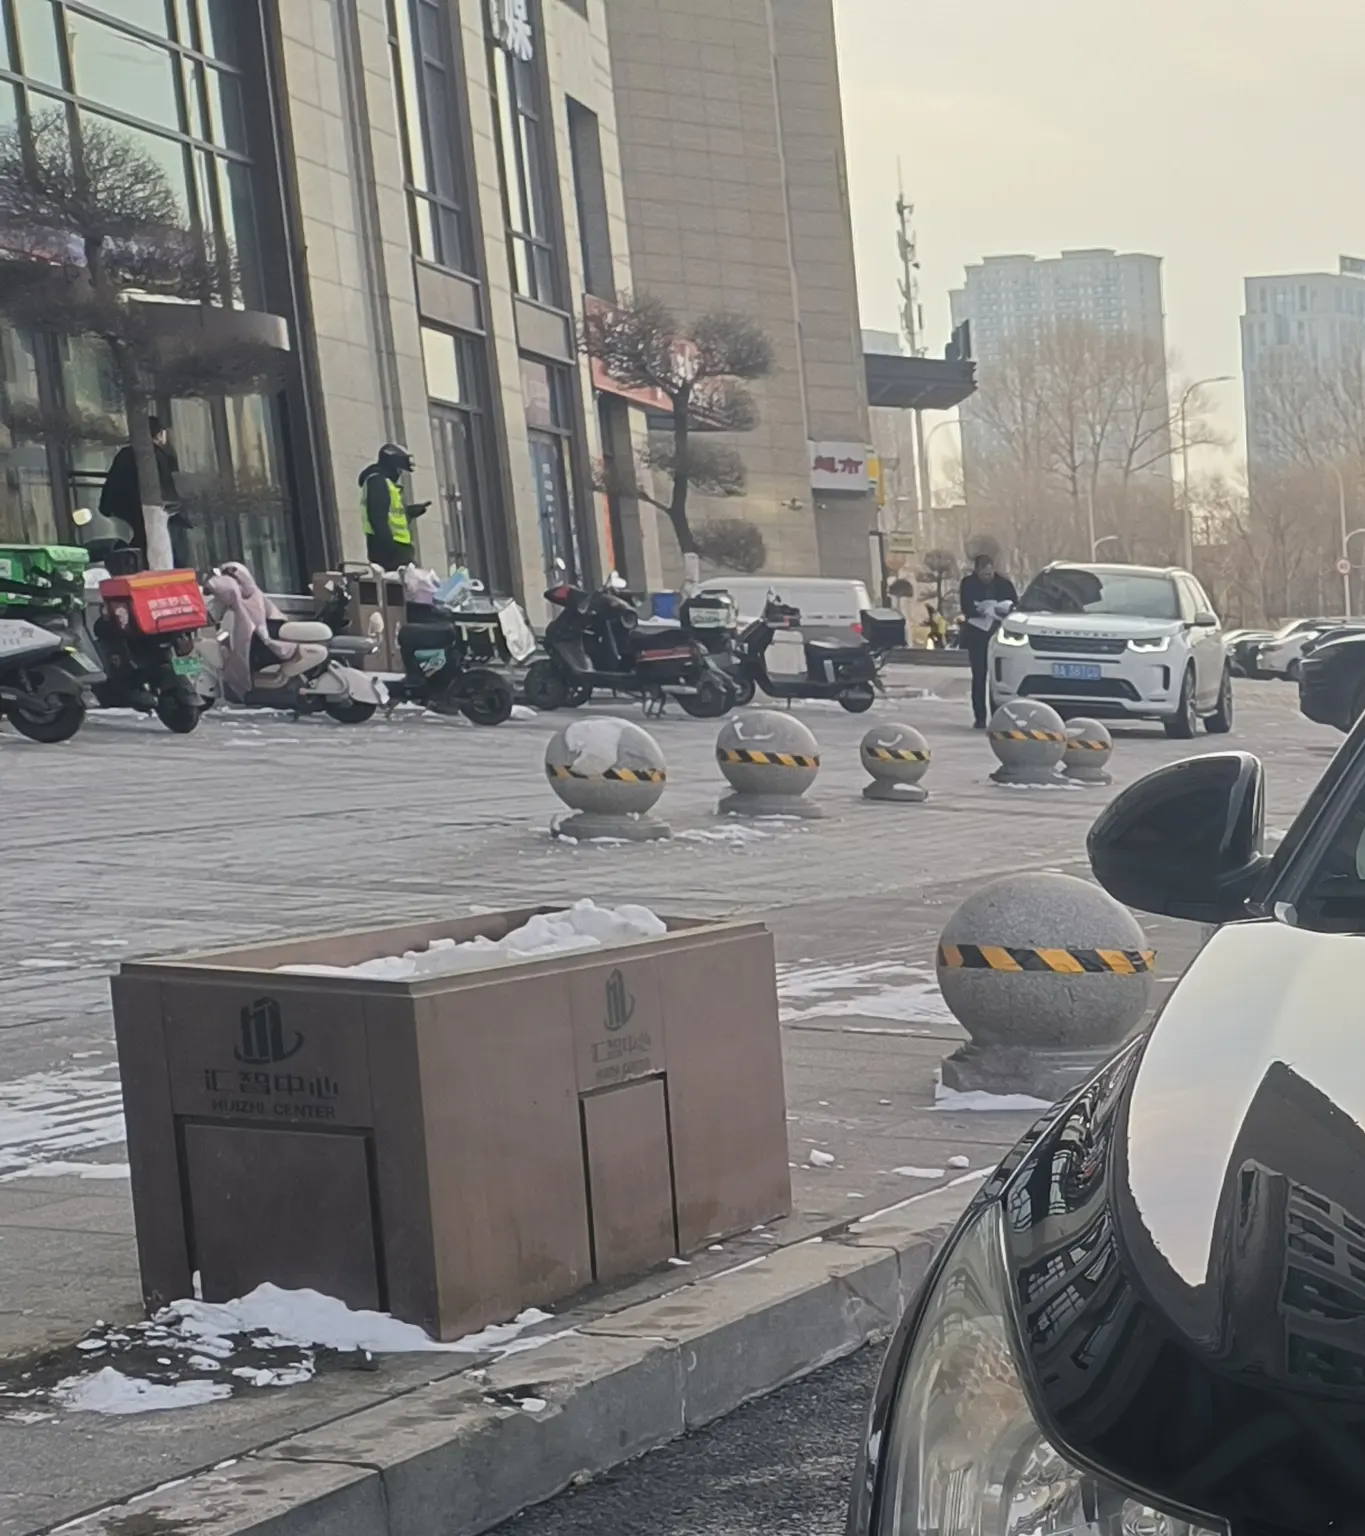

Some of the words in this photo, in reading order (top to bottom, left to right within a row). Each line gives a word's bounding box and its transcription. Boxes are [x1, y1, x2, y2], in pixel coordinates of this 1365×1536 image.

[204, 1068, 339, 1099] 汇智中心
[211, 1098, 266, 1115] HUIZHI
[272, 1102, 337, 1119] CENTER
